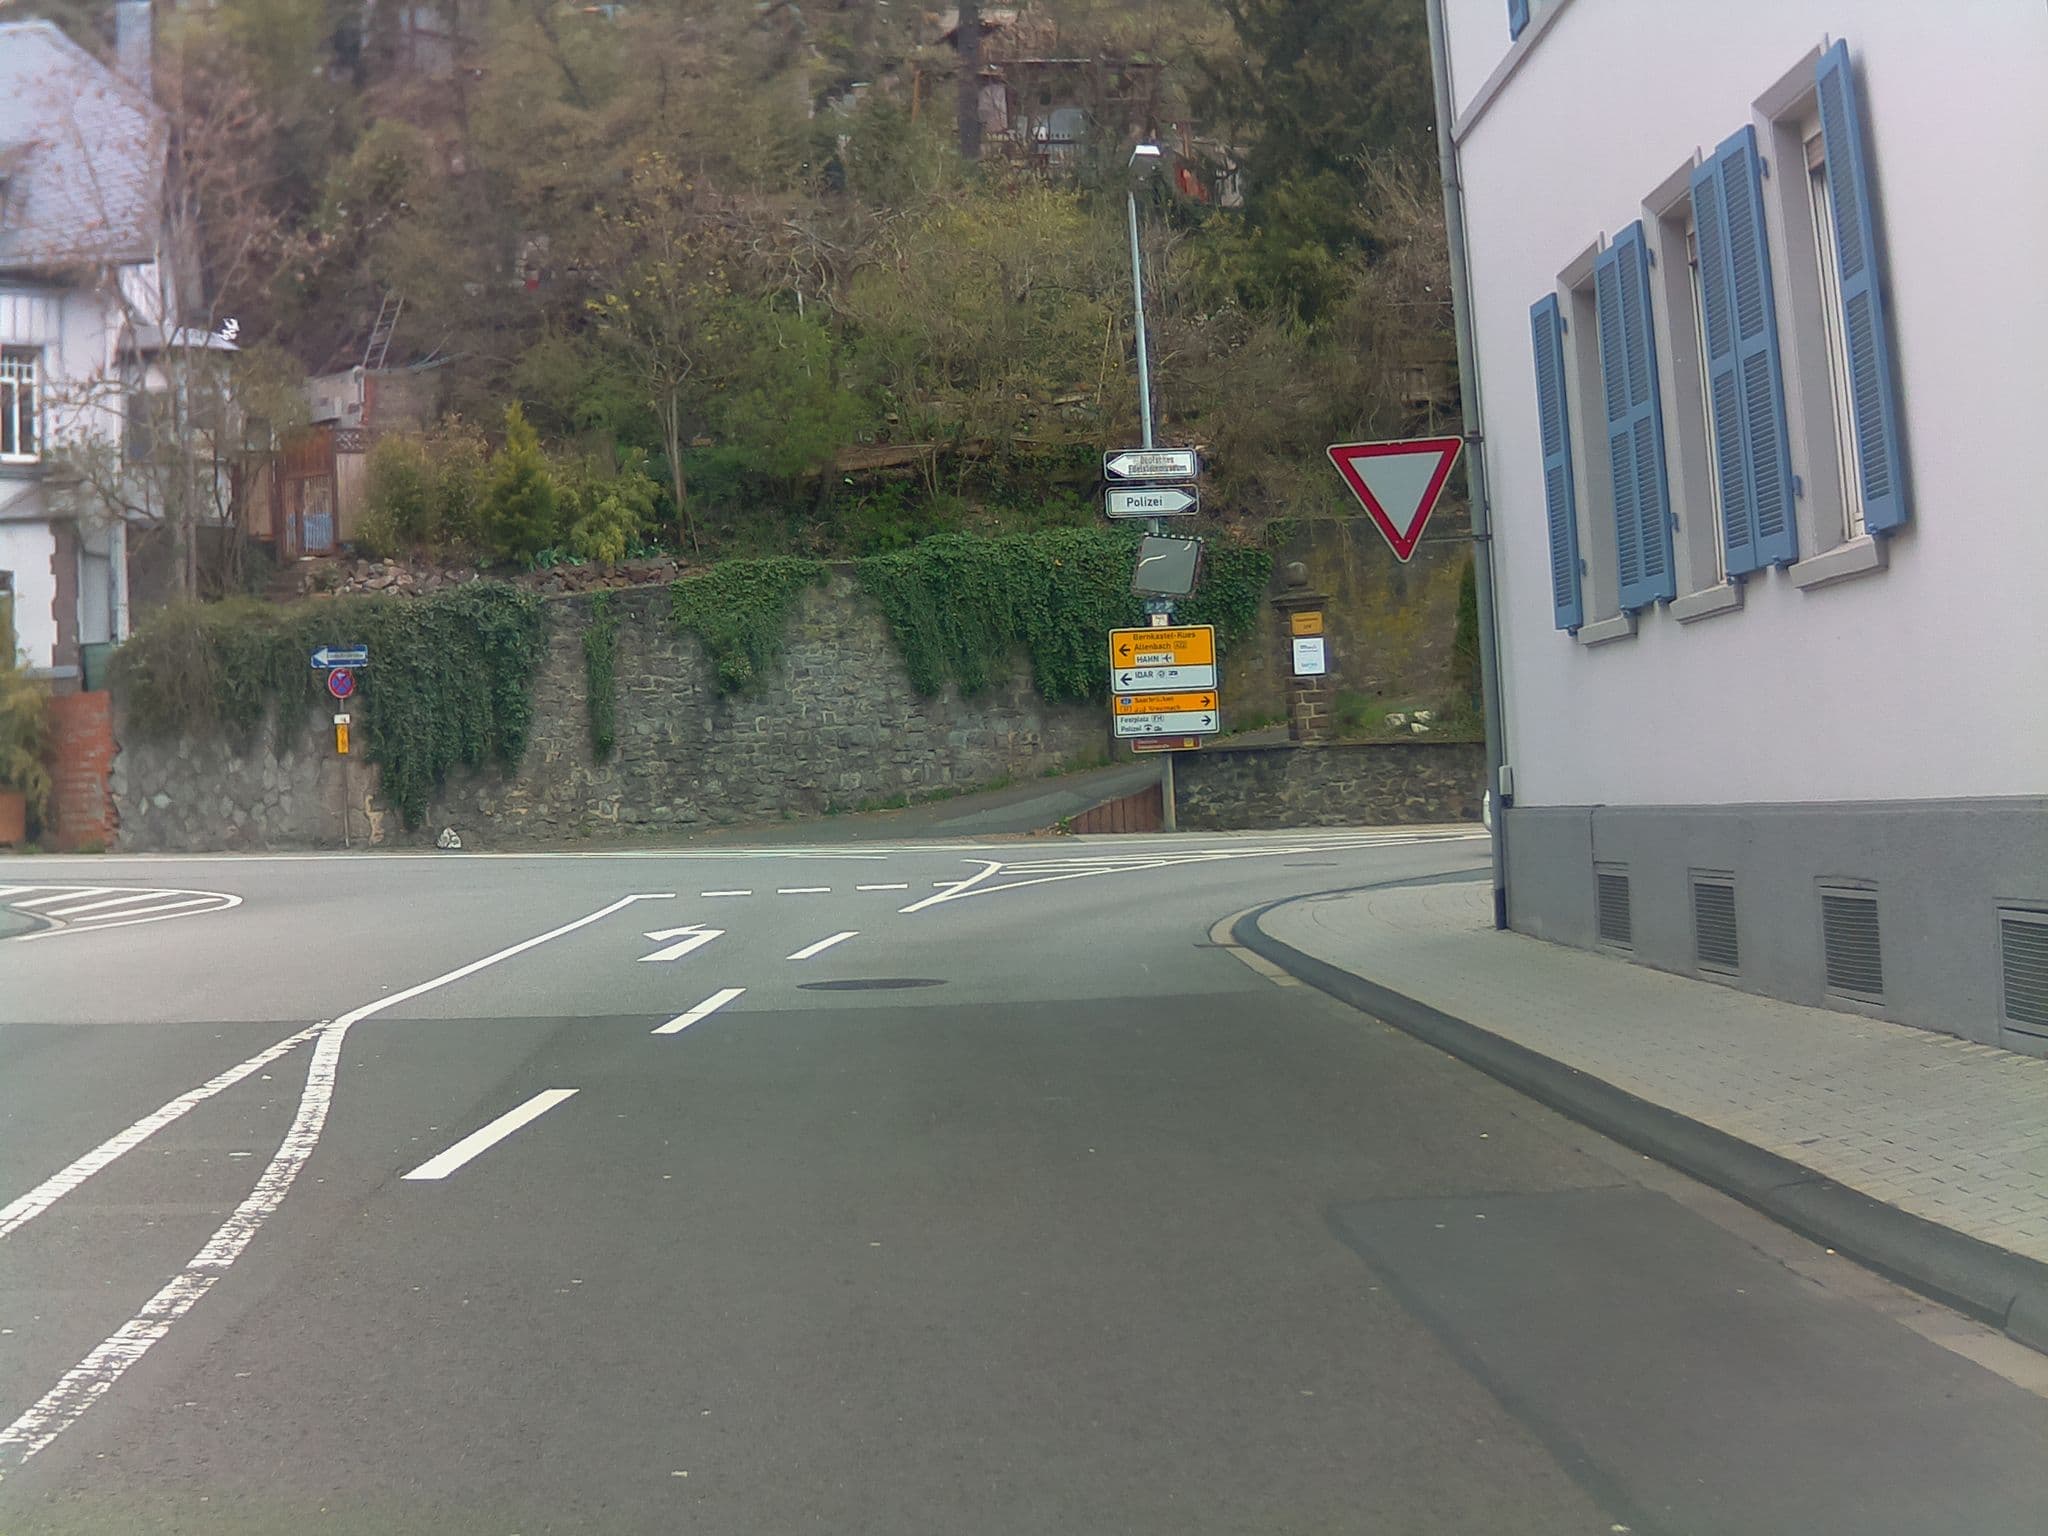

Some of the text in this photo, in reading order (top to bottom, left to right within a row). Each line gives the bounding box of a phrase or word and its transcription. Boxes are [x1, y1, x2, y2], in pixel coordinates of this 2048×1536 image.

[1126, 496, 1163, 507] Polizei
[1132, 632, 1196, 641] Bernkastel-Kues
[1136, 655, 1160, 663] HAHN
[1134, 670, 1154, 679] IDAR
